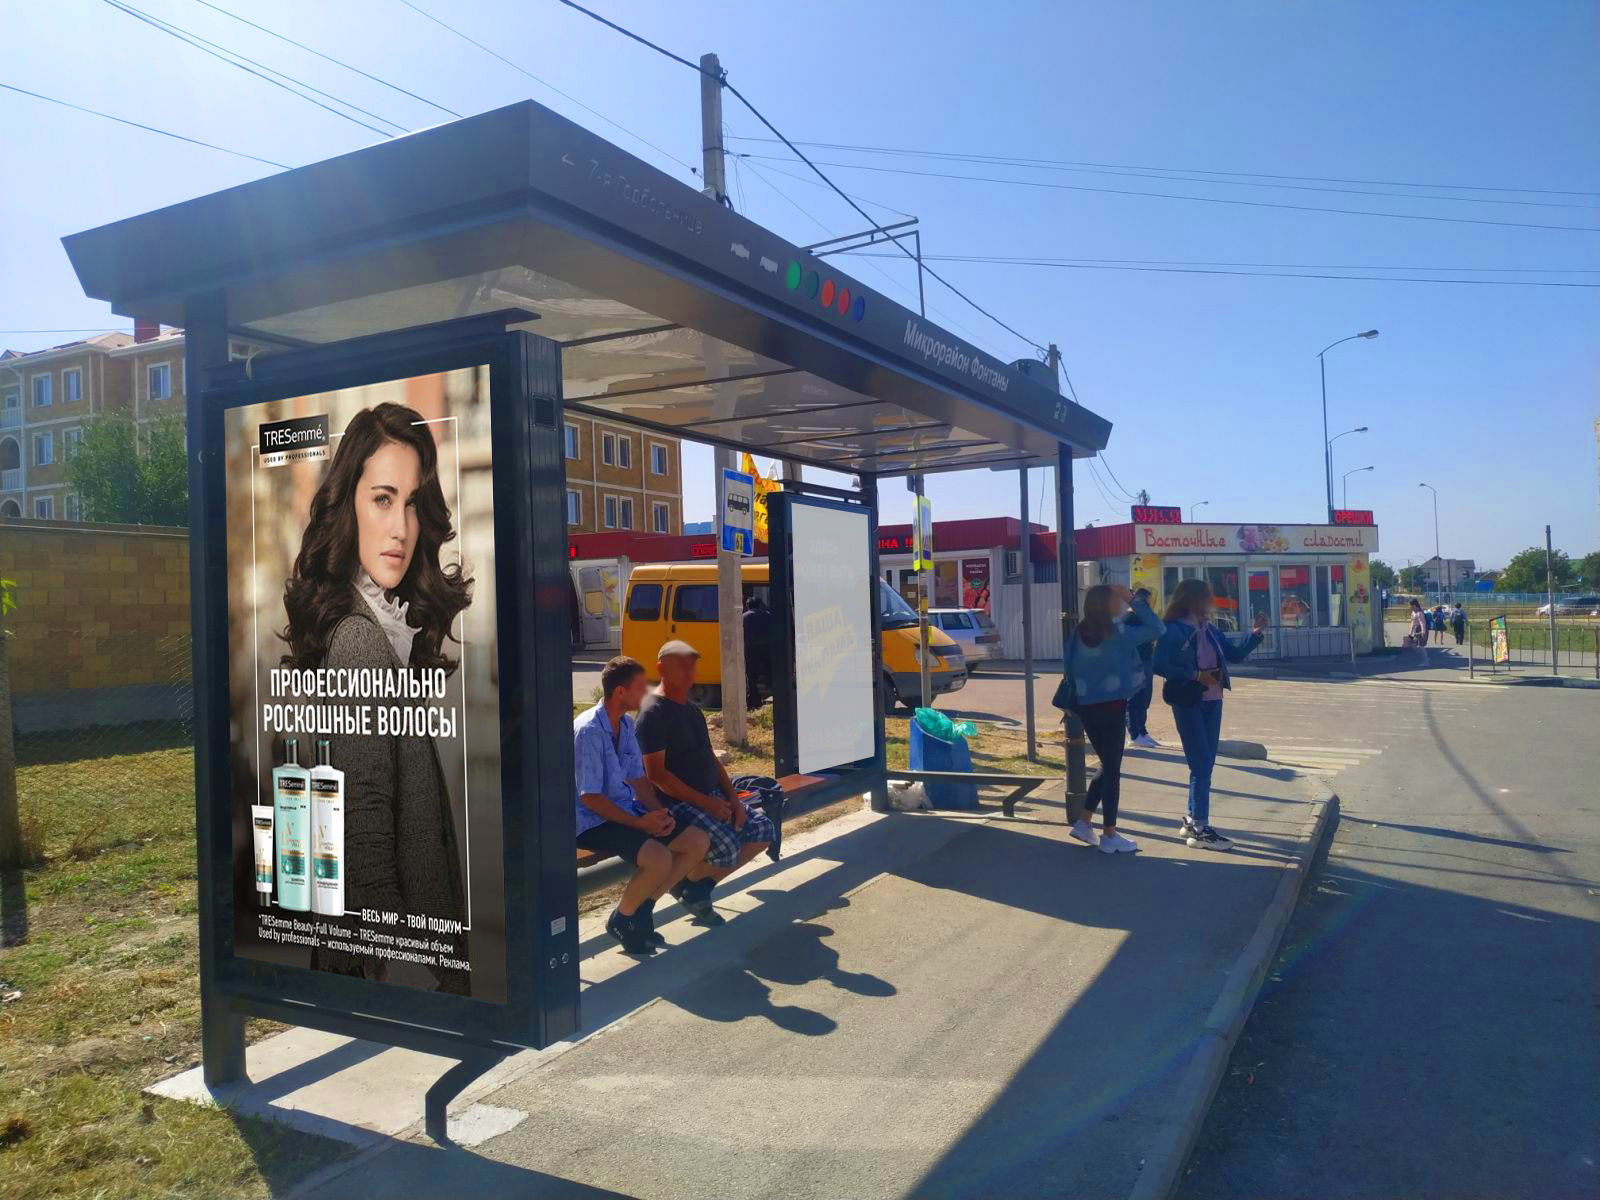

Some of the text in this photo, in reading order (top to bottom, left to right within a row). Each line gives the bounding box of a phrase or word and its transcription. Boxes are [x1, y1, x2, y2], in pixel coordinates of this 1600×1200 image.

[903, 319, 1010, 393] Микрорайон Фонтаны
[264, 456, 277, 464] USED
[285, 449, 326, 461] PROFESSIONALS
[270, 667, 446, 699] ПРОФЕССИОНАЛЬНО
[263, 703, 457, 739] РОСКОШНЫЕ ВОЛОСЫ
[293, 918, 328, 935] Beauty-Full
[328, 923, 352, 939] Volume
[359, 928, 395, 946] TRESemme
[395, 937, 429, 951] красивый
[430, 939, 454, 954] объем
[362, 908, 380, 923] ВЕСЬ
[381, 911, 399, 926] МИР
[406, 913, 427, 930] ТВОЙ
[428, 917, 462, 935] ПОДИУМ
[258, 927, 273, 940] Used
[273, 928, 281, 943] by
[281, 931, 321, 948] professionals
[327, 939, 374, 956] используемый
[375, 947, 438, 967] профессионалами.
[439, 954, 472, 972] Реклама.
